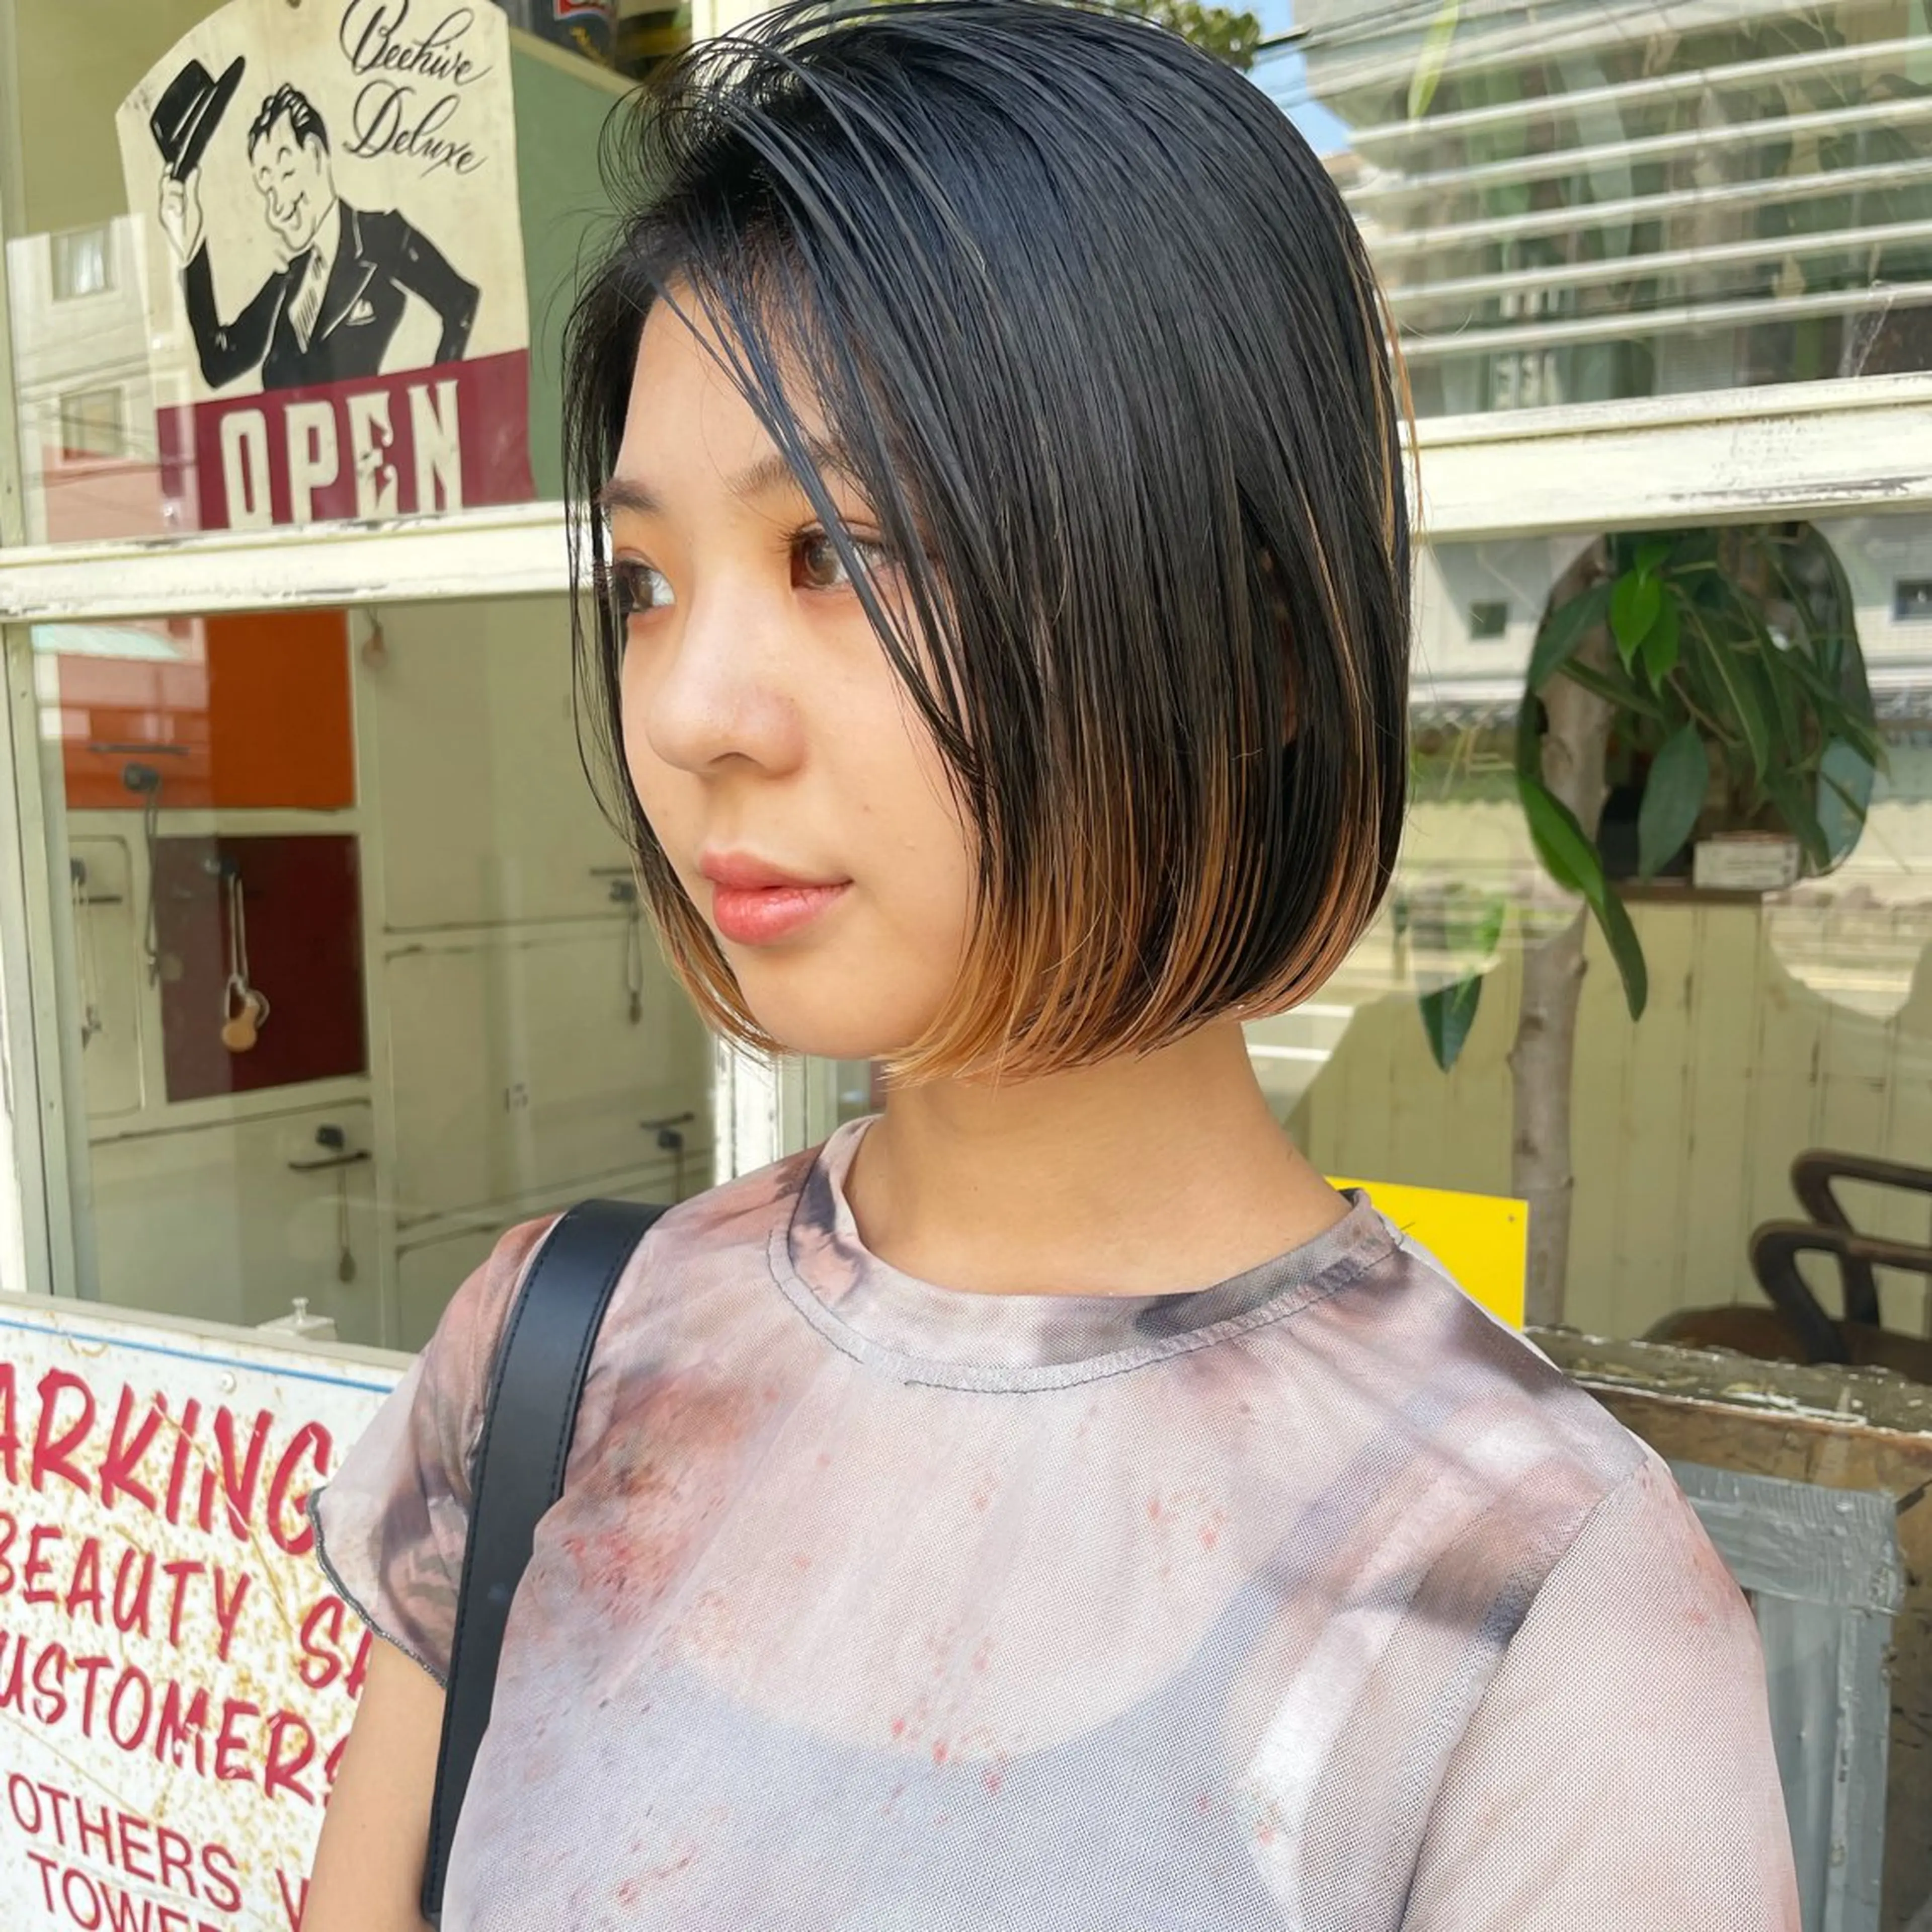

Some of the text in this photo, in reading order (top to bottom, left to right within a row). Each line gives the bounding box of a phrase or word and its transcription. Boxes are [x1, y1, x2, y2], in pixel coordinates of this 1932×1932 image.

[340, 0, 493, 86] Beehive
[341, 78, 488, 180] Deluxe
[220, 380, 463, 530] OPEN
[8, 1773, 242, 1913] OTHERS
